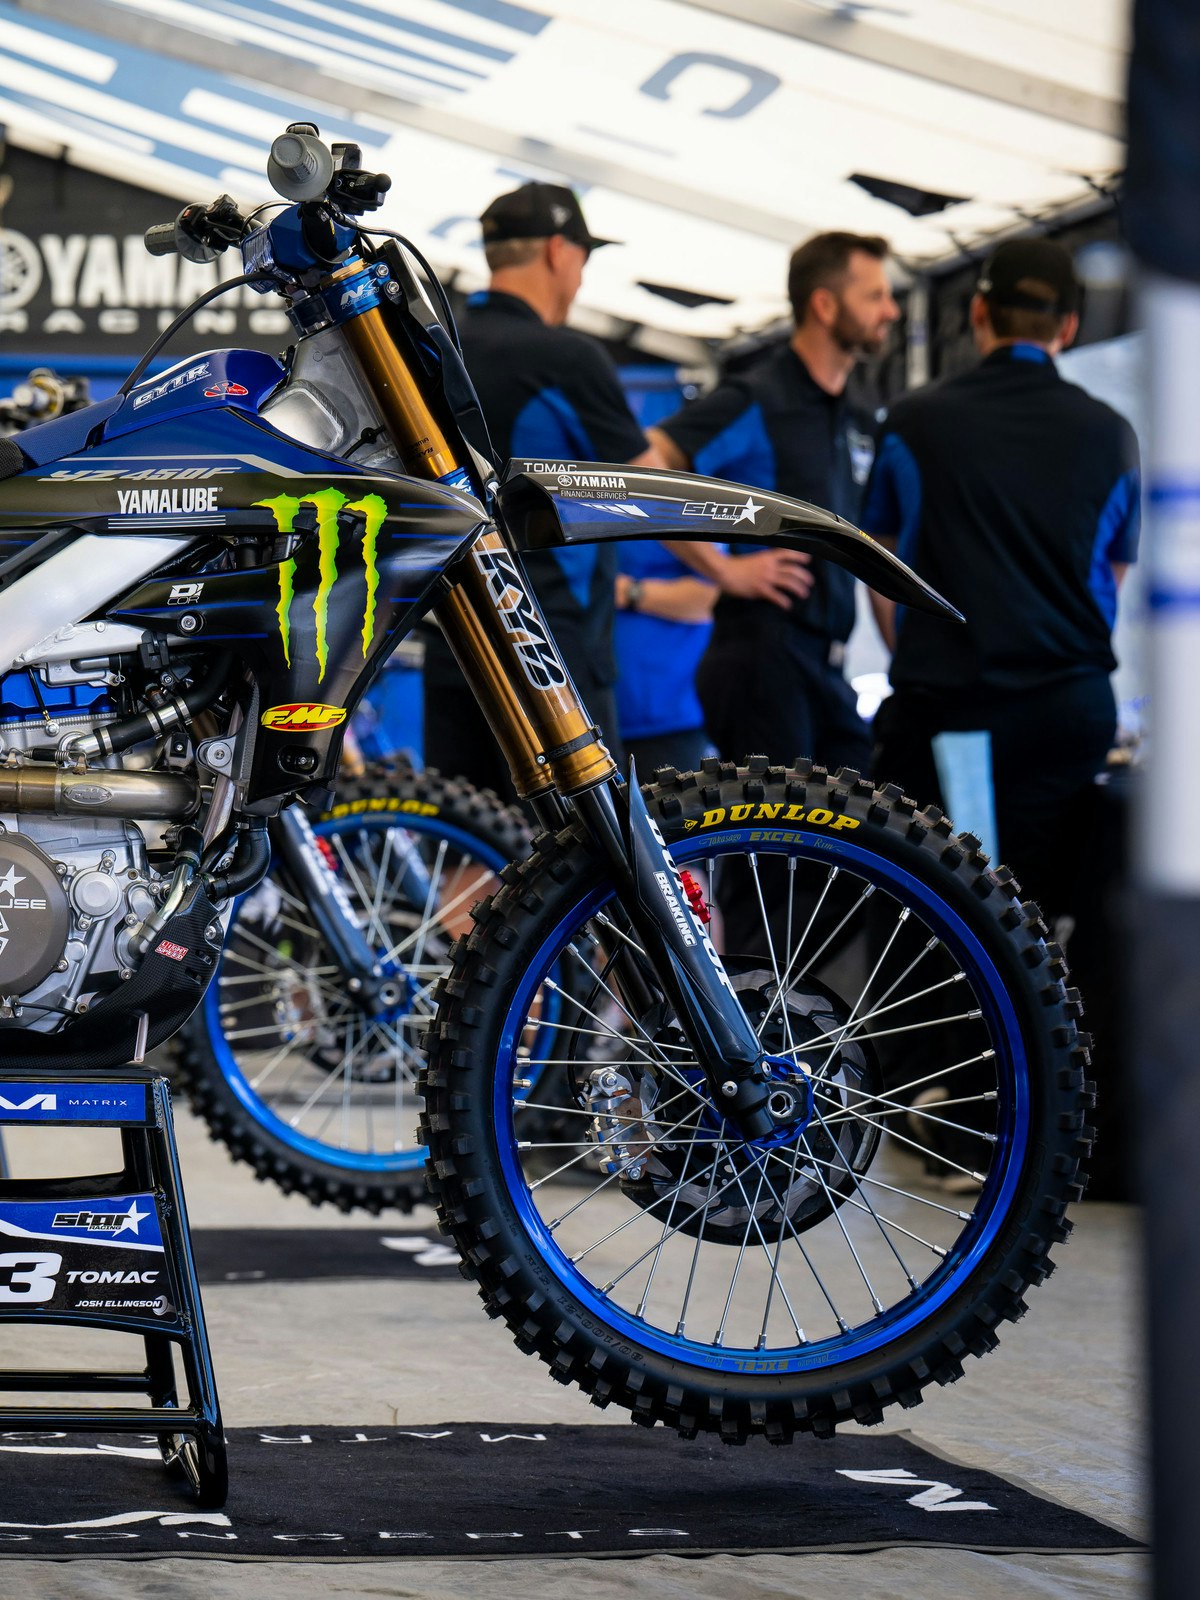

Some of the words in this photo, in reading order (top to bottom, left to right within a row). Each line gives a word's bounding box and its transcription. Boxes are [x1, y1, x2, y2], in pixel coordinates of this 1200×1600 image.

[133, 362, 210, 408] GYTR
[523, 462, 577, 474] TOMAC
[572, 474, 626, 489] YAMAHA
[116, 487, 218, 515] YAMALUBE
[560, 490, 595, 499] FINANCIAL
[596, 491, 627, 500] SERVICES
[472, 548, 567, 691] KYB
[262, 706, 347, 726] FMF
[699, 803, 861, 831] DUNLOP
[749, 832, 804, 844] EXCEL
[656, 872, 696, 946] BRAKING
[65, 1271, 160, 1284] TOMAC
[75, 1300, 103, 1308] JOSH
[104, 1300, 161, 1308] ELLINGSON
[734, 1360, 789, 1371] EXCEL
